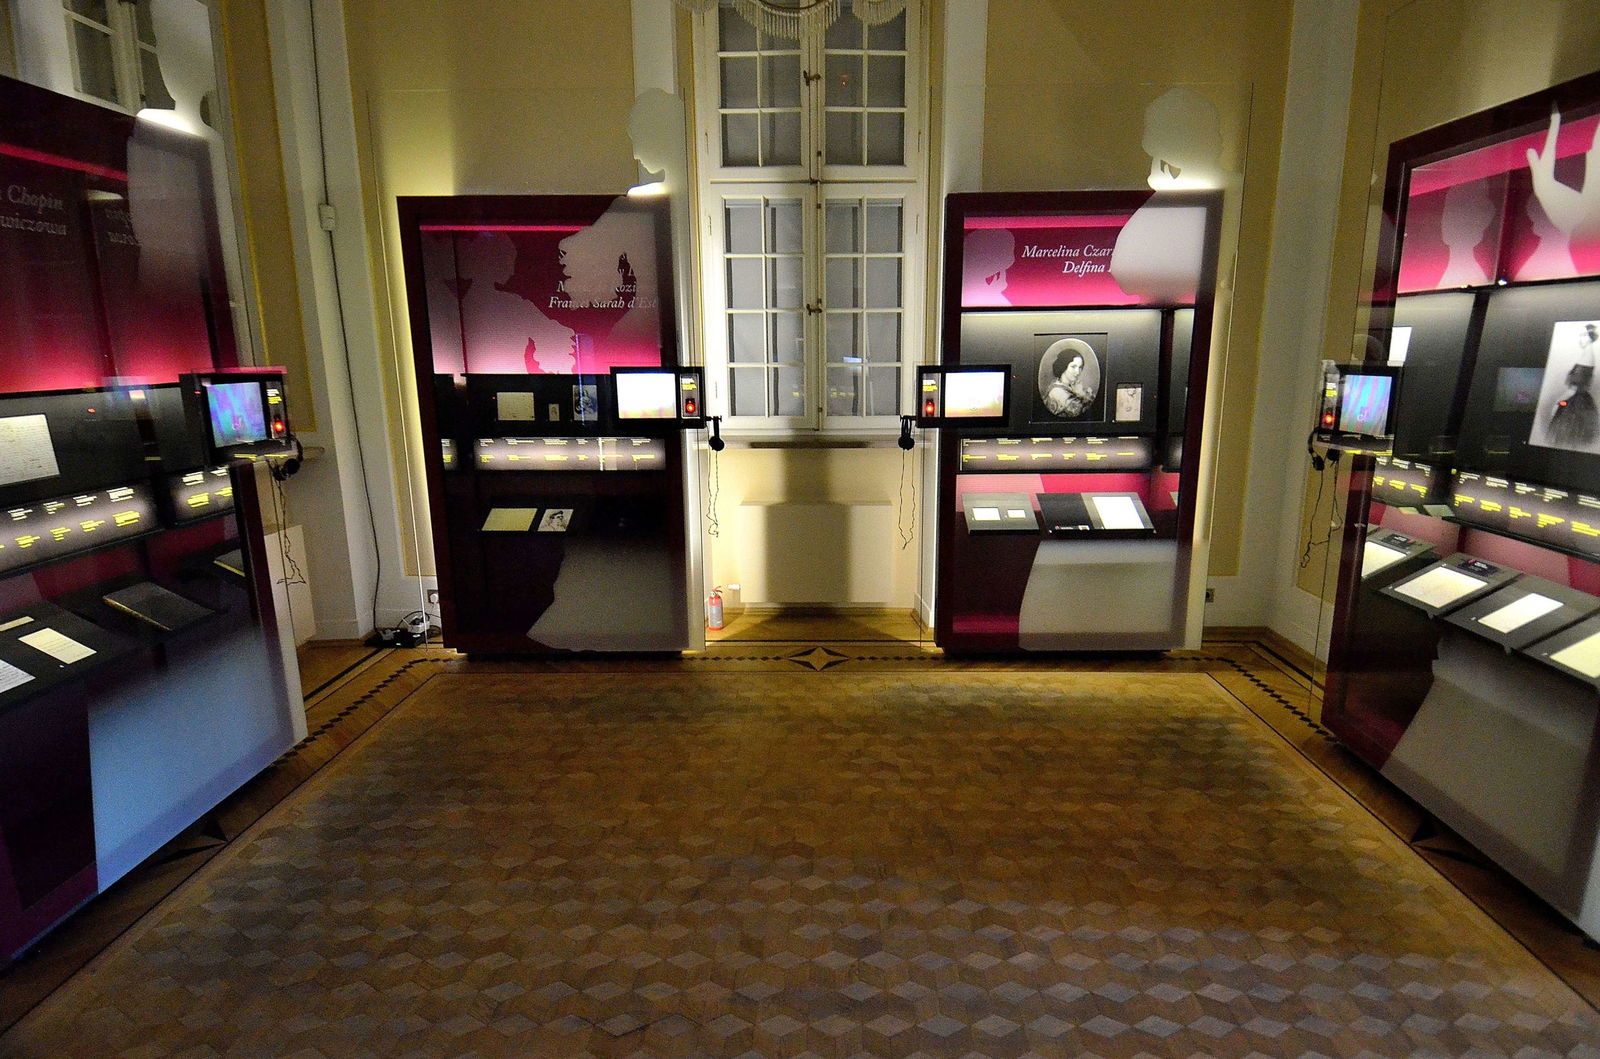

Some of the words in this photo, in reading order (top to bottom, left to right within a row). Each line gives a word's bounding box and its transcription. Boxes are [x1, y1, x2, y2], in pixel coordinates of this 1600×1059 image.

[8, 184, 64, 214] Chopin
[1021, 244, 1080, 258] Marcelina
[1062, 260, 1106, 277] Delfina
[592, 296, 625, 308] Sarah
